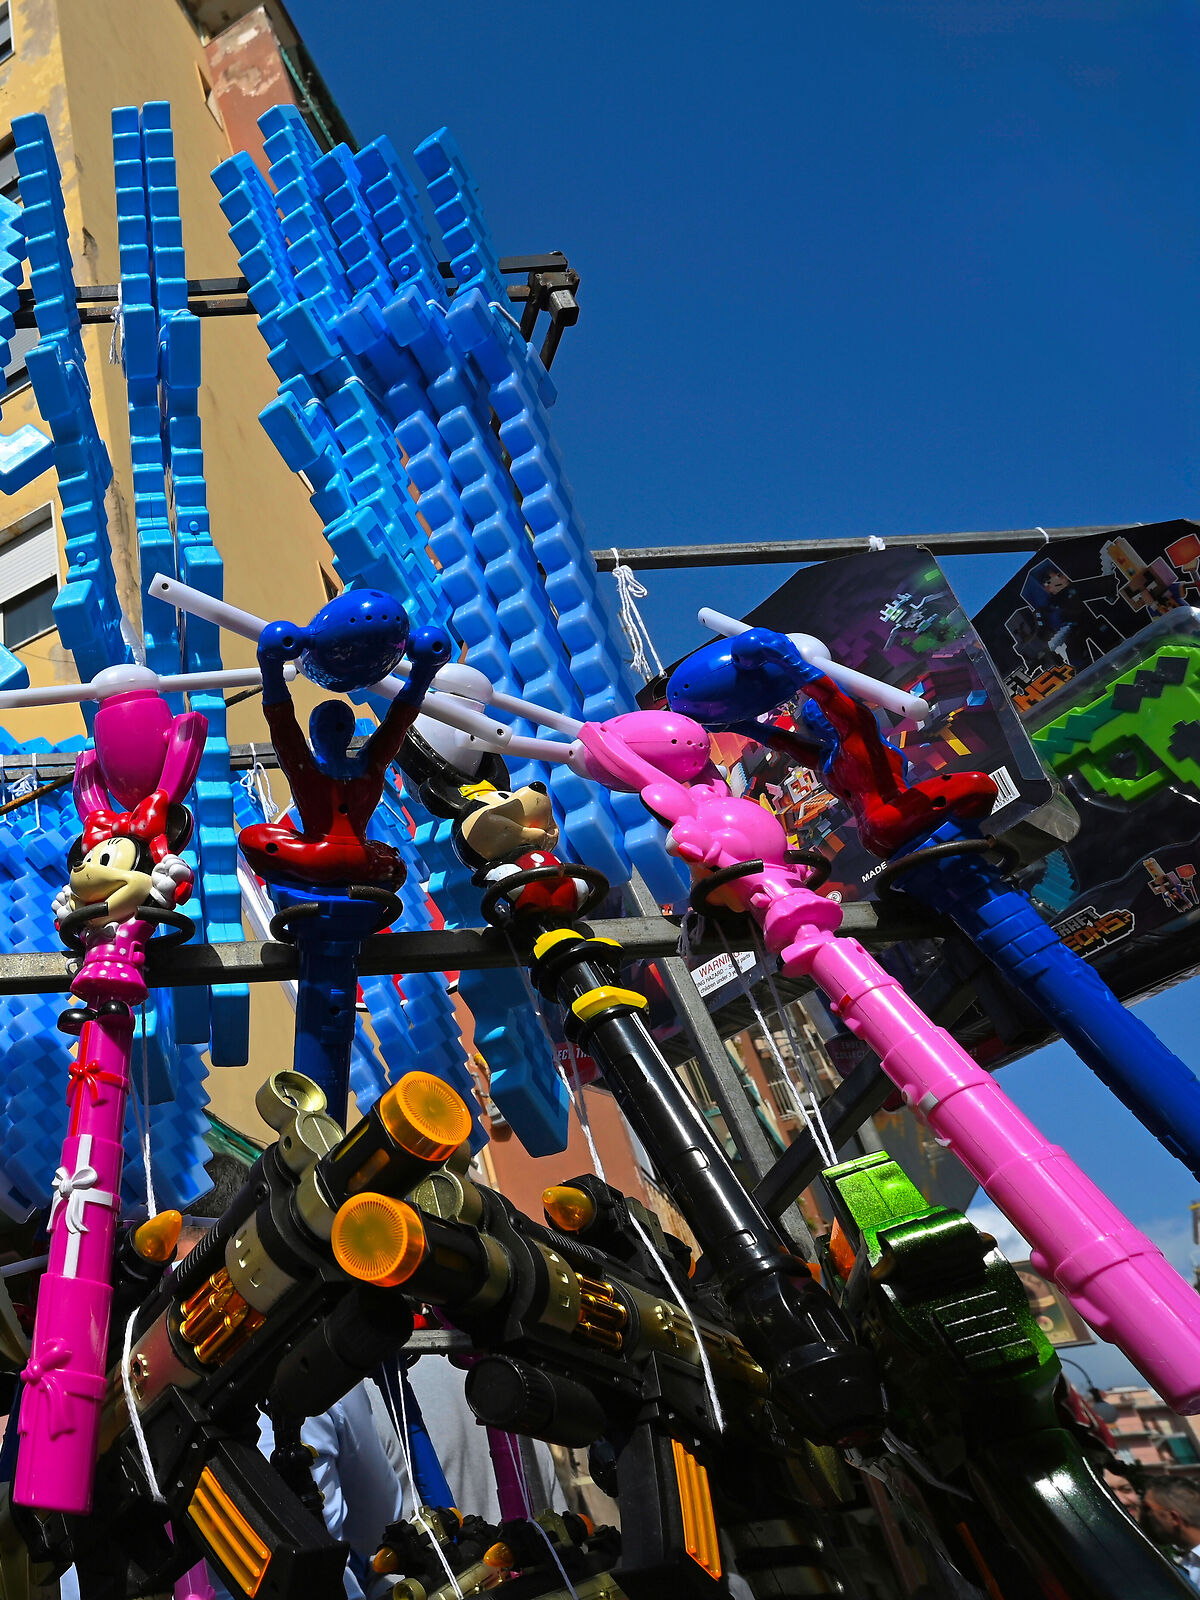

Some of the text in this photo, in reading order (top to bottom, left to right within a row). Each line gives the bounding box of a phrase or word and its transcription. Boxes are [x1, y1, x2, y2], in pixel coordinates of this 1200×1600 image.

[861, 861, 888, 883] MADE
[700, 981, 717, 994] children
[717, 974, 728, 985] under
[705, 968, 724, 983] HAZARD
